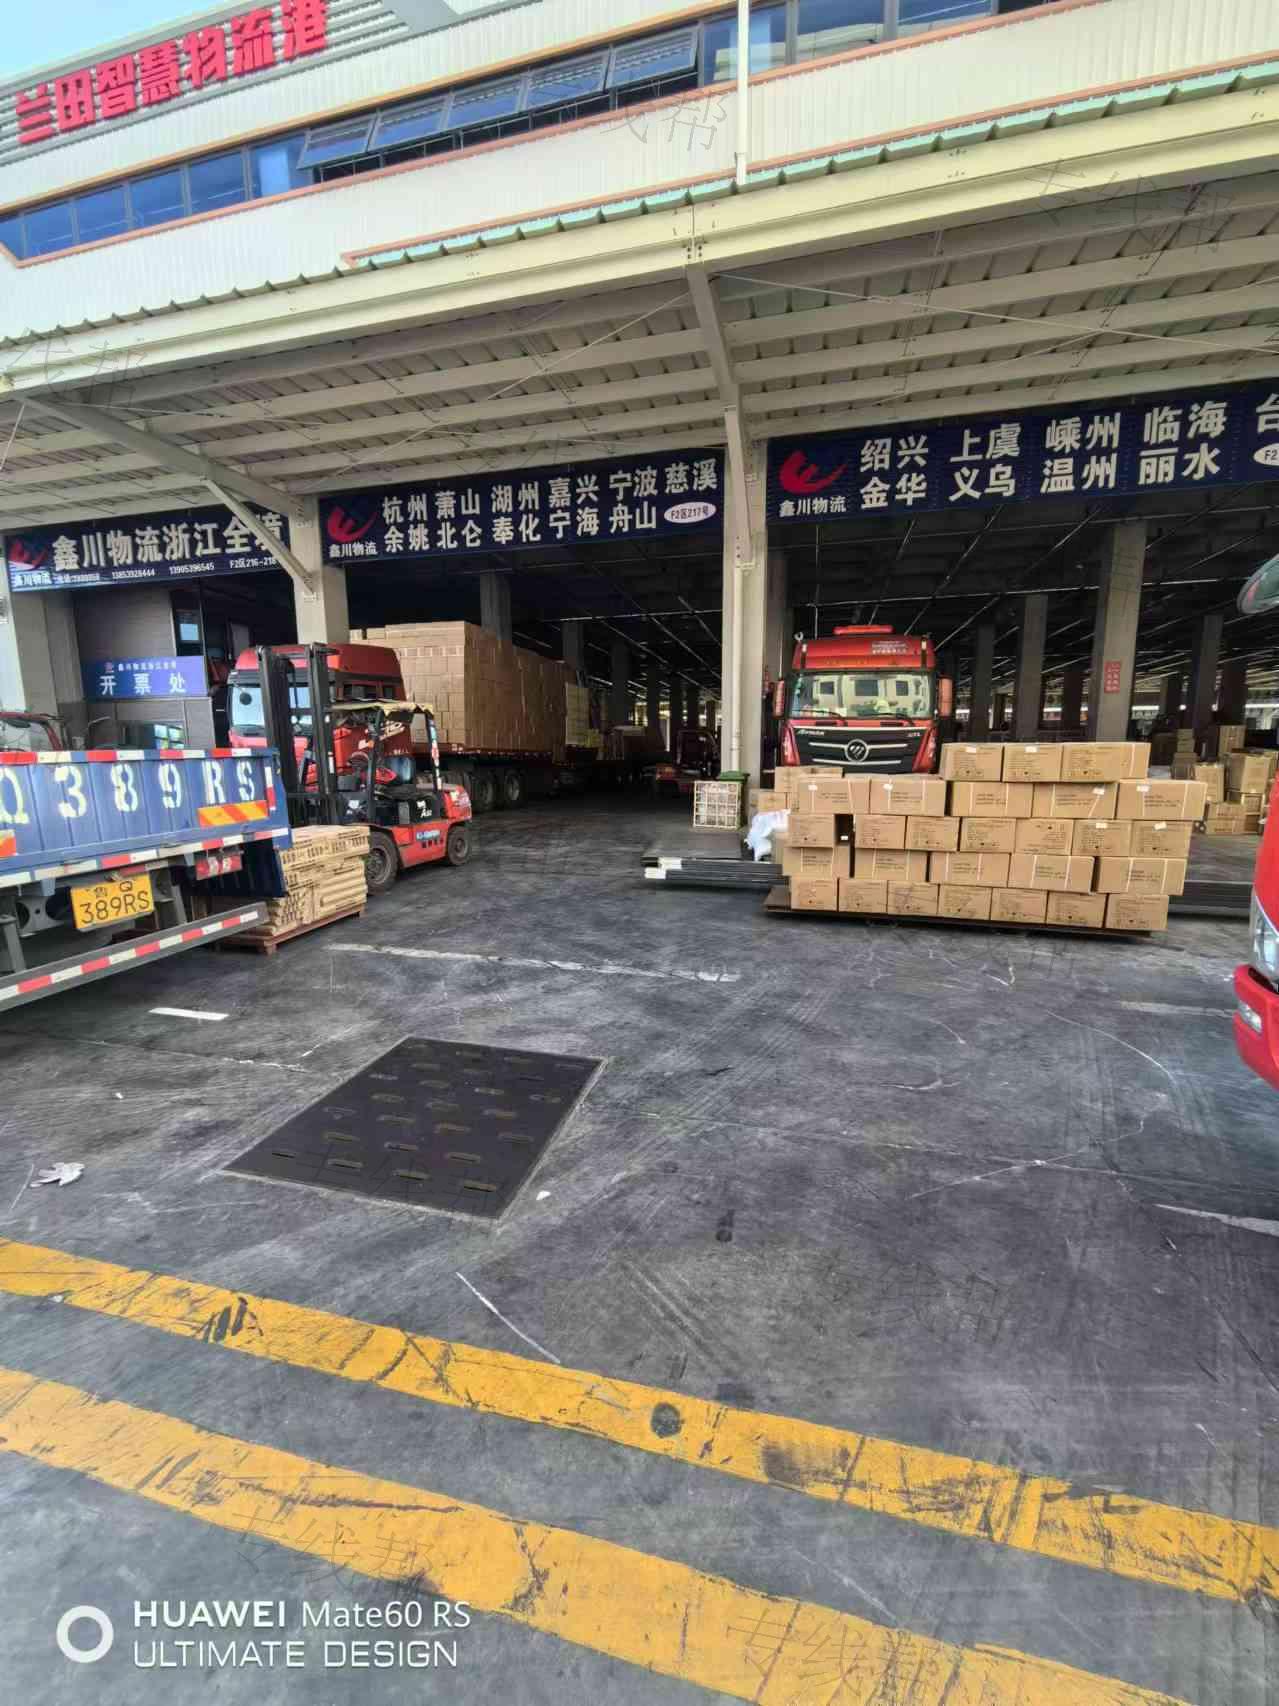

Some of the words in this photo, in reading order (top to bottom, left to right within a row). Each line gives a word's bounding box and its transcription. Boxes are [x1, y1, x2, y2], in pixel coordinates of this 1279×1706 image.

[16, 0, 328, 145] 兰田智慧物流港
[859, 435, 929, 473] 绍兴
[950, 423, 1021, 464] 上虞
[1046, 412, 1120, 454] 嵊州
[1143, 400, 1228, 445] 临海
[382, 493, 429, 523] 杭州
[434, 488, 481, 519] 萧山
[492, 481, 541, 512] 湖州
[548, 474, 600, 508] 嘉兴
[609, 467, 659, 500] 宁波
[664, 457, 718, 495] 慈溪
[859, 473, 928, 510] 金华
[949, 464, 1017, 503] 义乌
[1040, 451, 1118, 494] 温州
[1137, 443, 1221, 486] 丽水
[383, 524, 430, 554] 余姚
[436, 518, 483, 548] 北仑
[492, 515, 542, 546] 奉化
[548, 507, 600, 540] 宁海
[609, 501, 657, 534] 舟山
[779, 495, 848, 518] 鑫川物流
[328, 541, 378, 559] 鑫川物流
[99, 672, 187, 696] 开票处
[79, 890, 151, 925] 389RS
